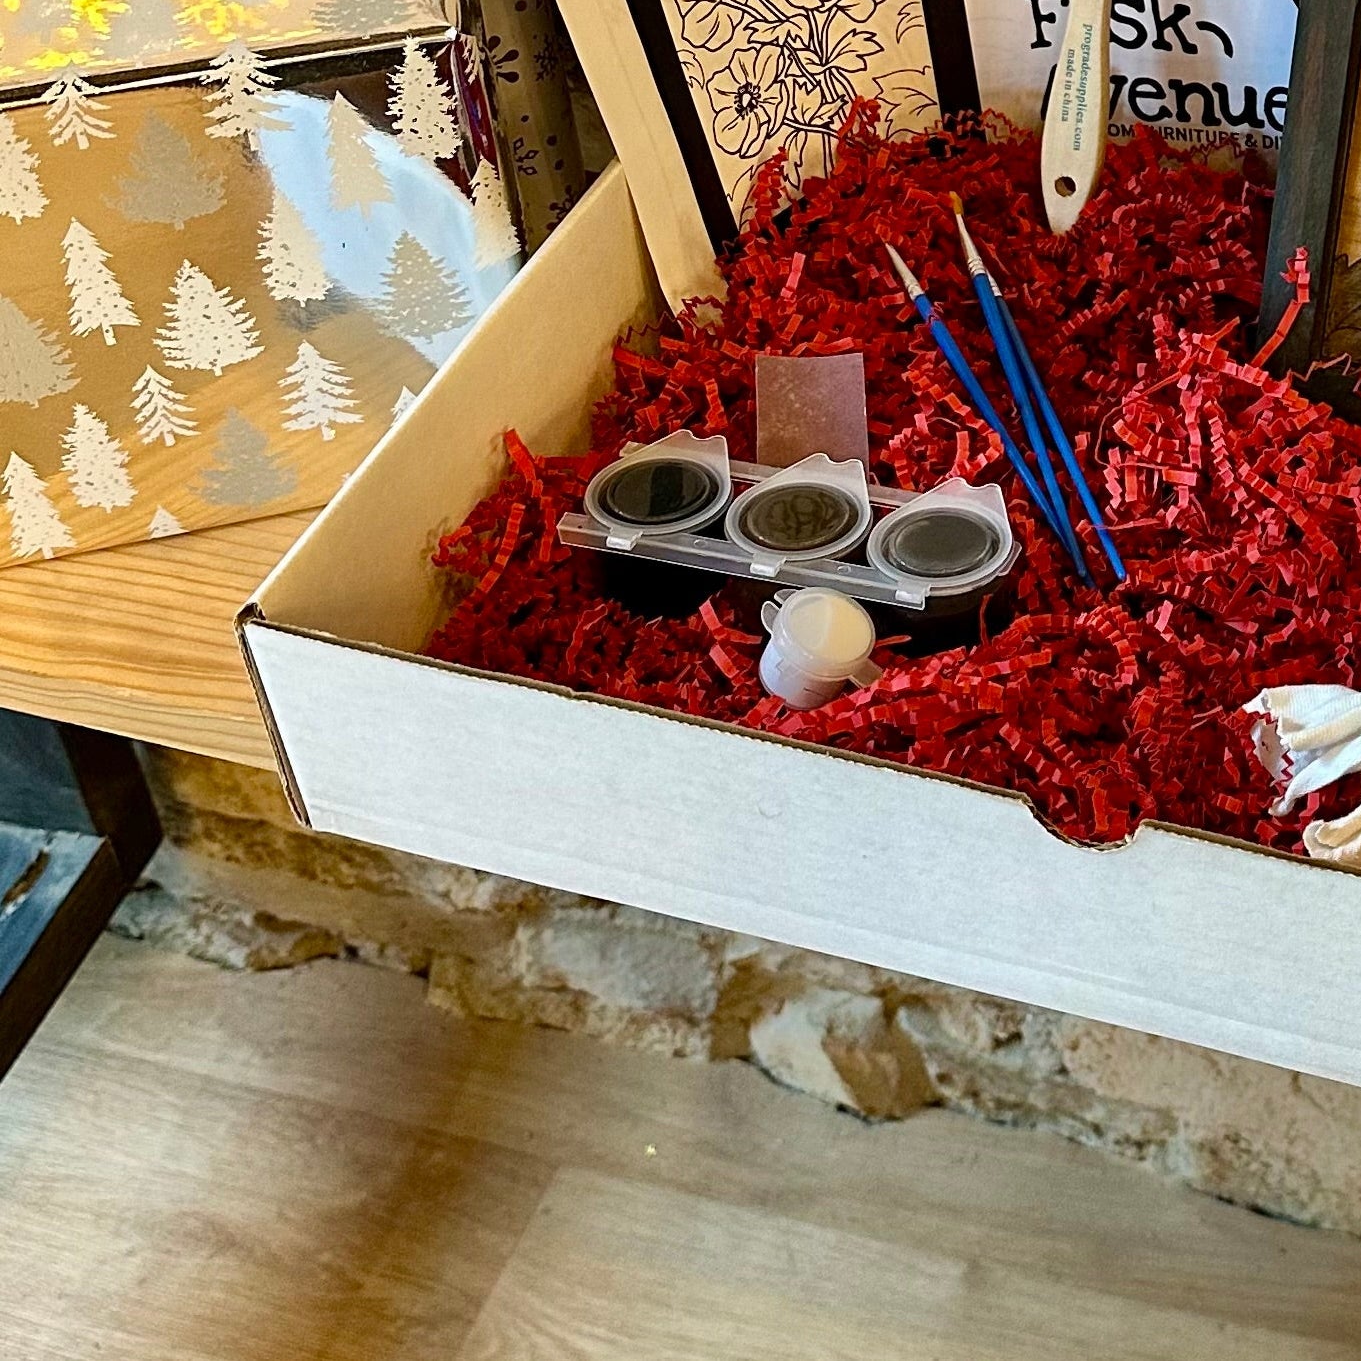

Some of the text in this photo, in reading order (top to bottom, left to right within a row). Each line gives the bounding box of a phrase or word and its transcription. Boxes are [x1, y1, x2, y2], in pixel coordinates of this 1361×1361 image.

[1065, 49, 1076, 78] made
[1040, 63, 1290, 133] enue
[1072, 23, 1093, 151] progradesupplies.com
[1061, 92, 1074, 122] china
[1145, 125, 1240, 144] RNITURE
[1244, 133, 1258, 148] &
[1262, 134, 1283, 150] DI
